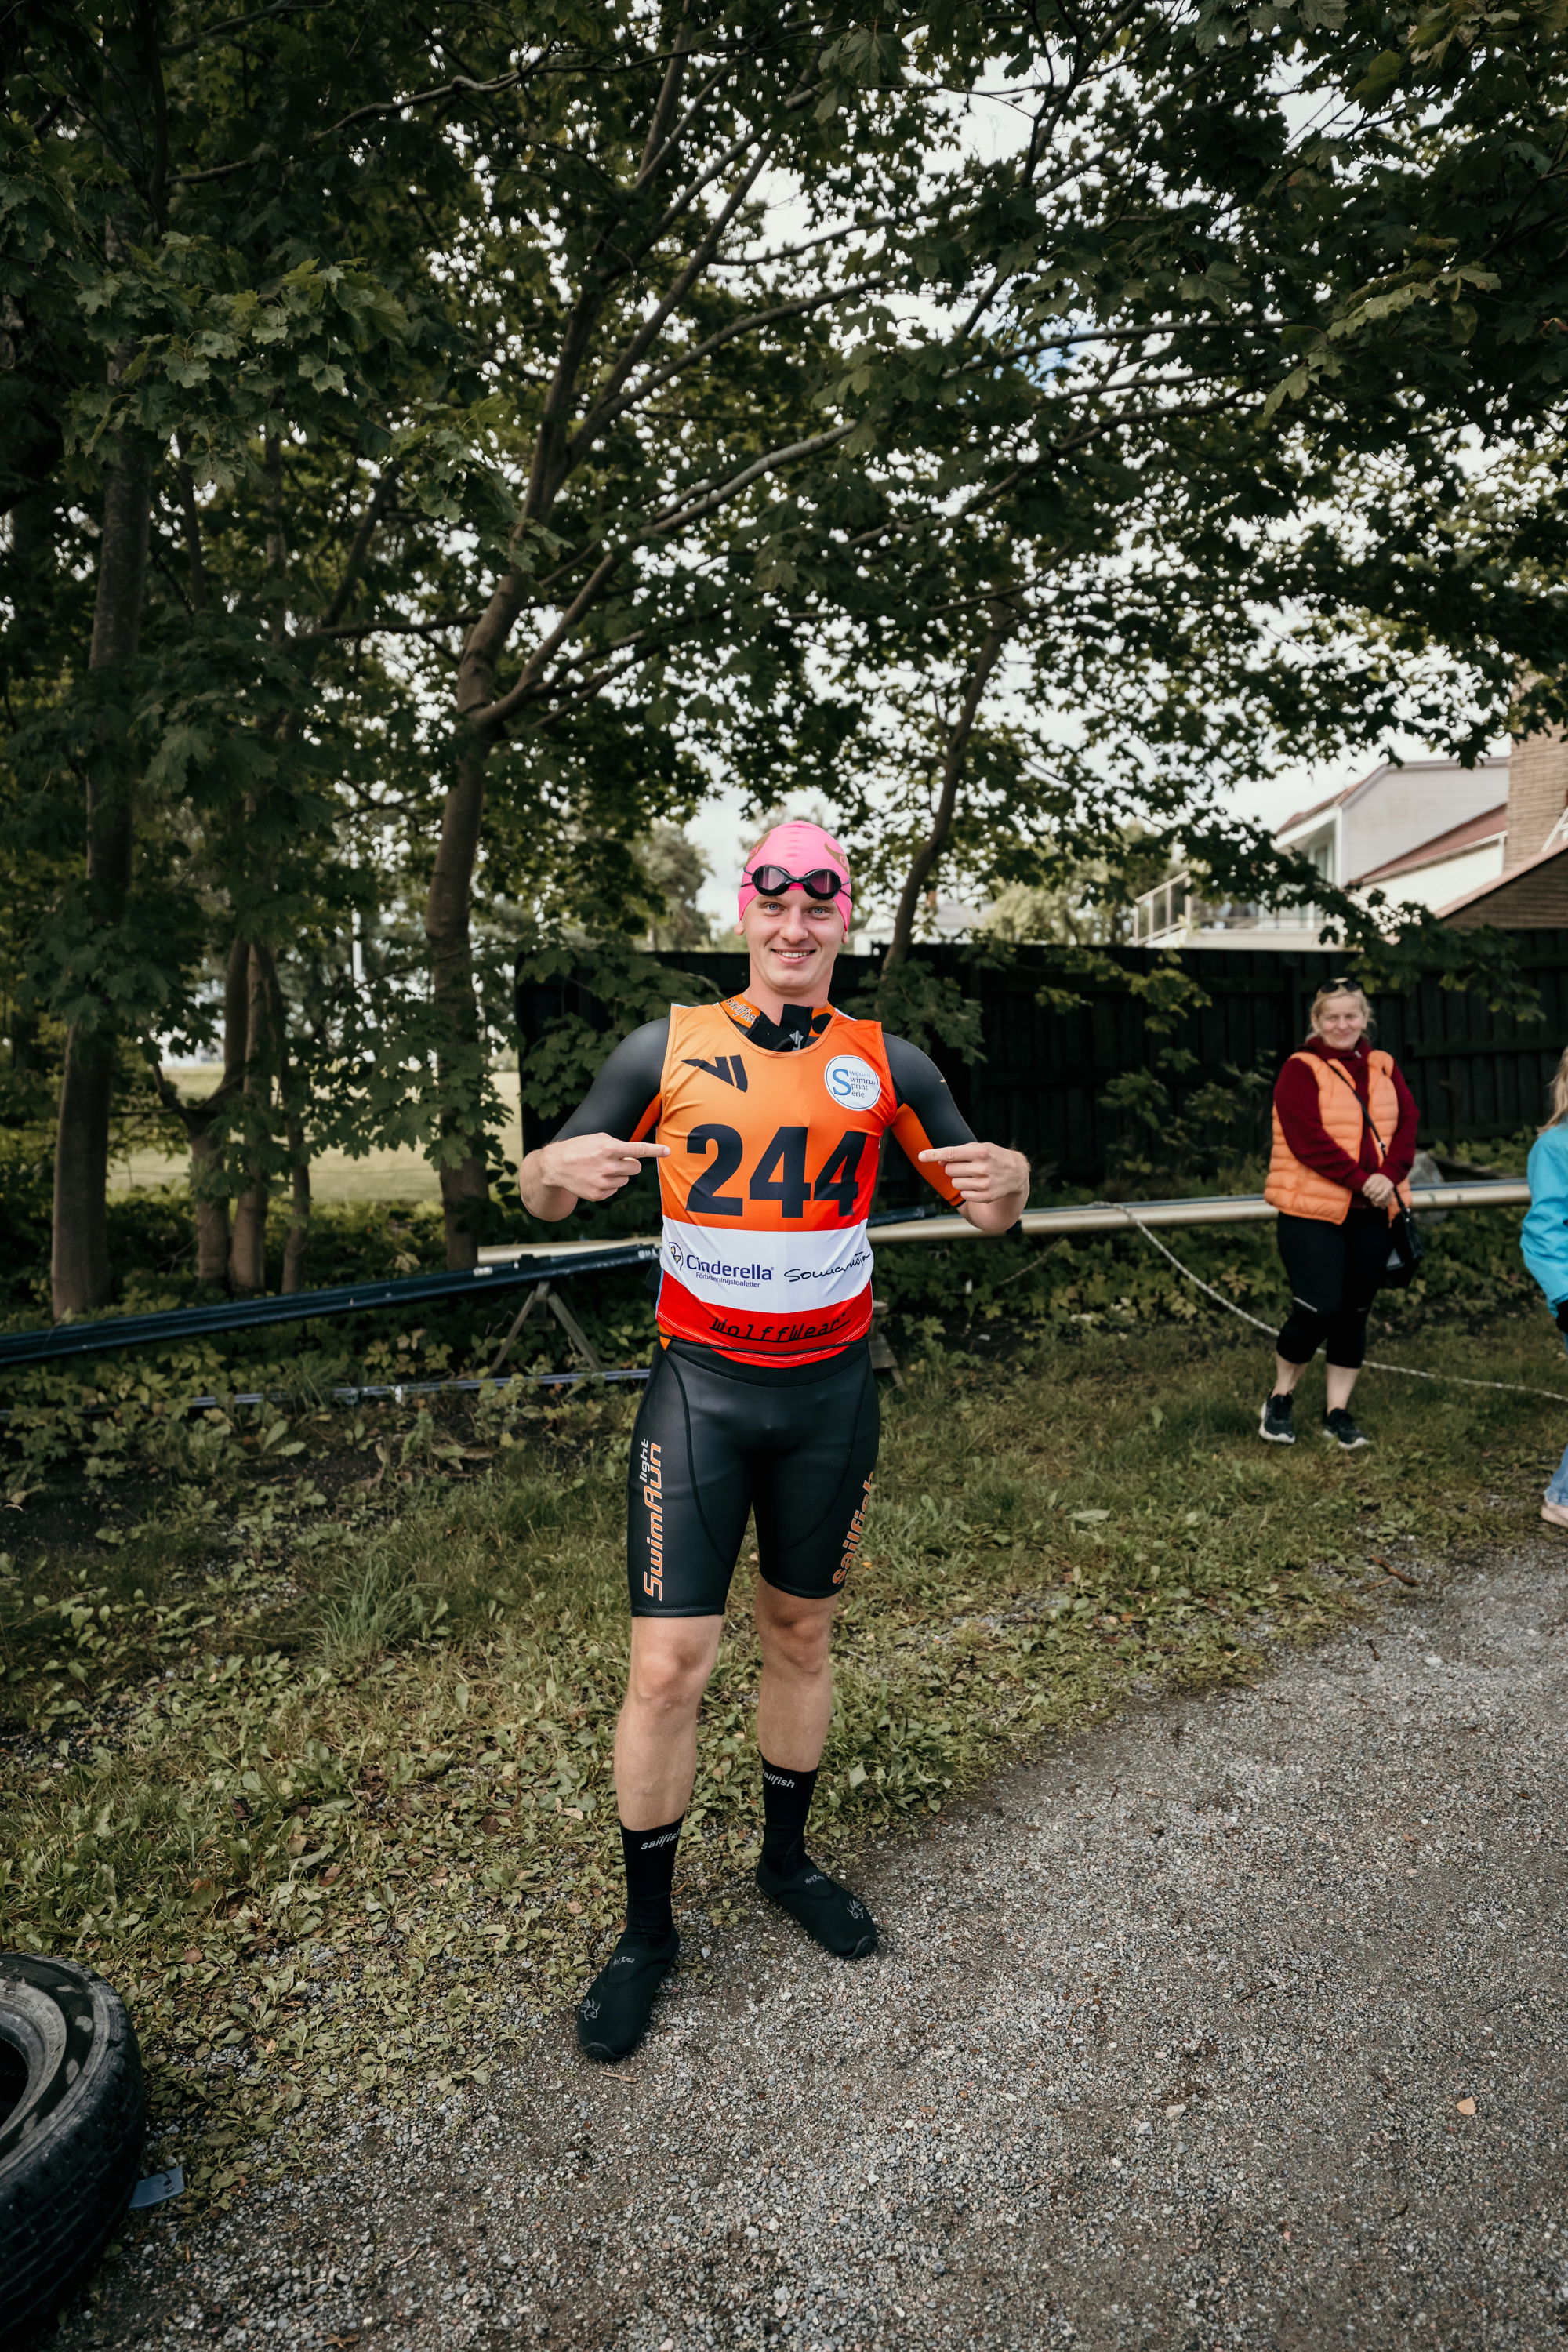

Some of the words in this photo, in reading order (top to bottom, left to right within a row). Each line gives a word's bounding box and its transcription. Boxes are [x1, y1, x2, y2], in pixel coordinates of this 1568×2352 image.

[725, 998, 756, 1023] sailfis
[685, 1123, 868, 1218] 244
[639, 1438, 650, 1483] light
[764, 1771, 795, 1788] ailfish
